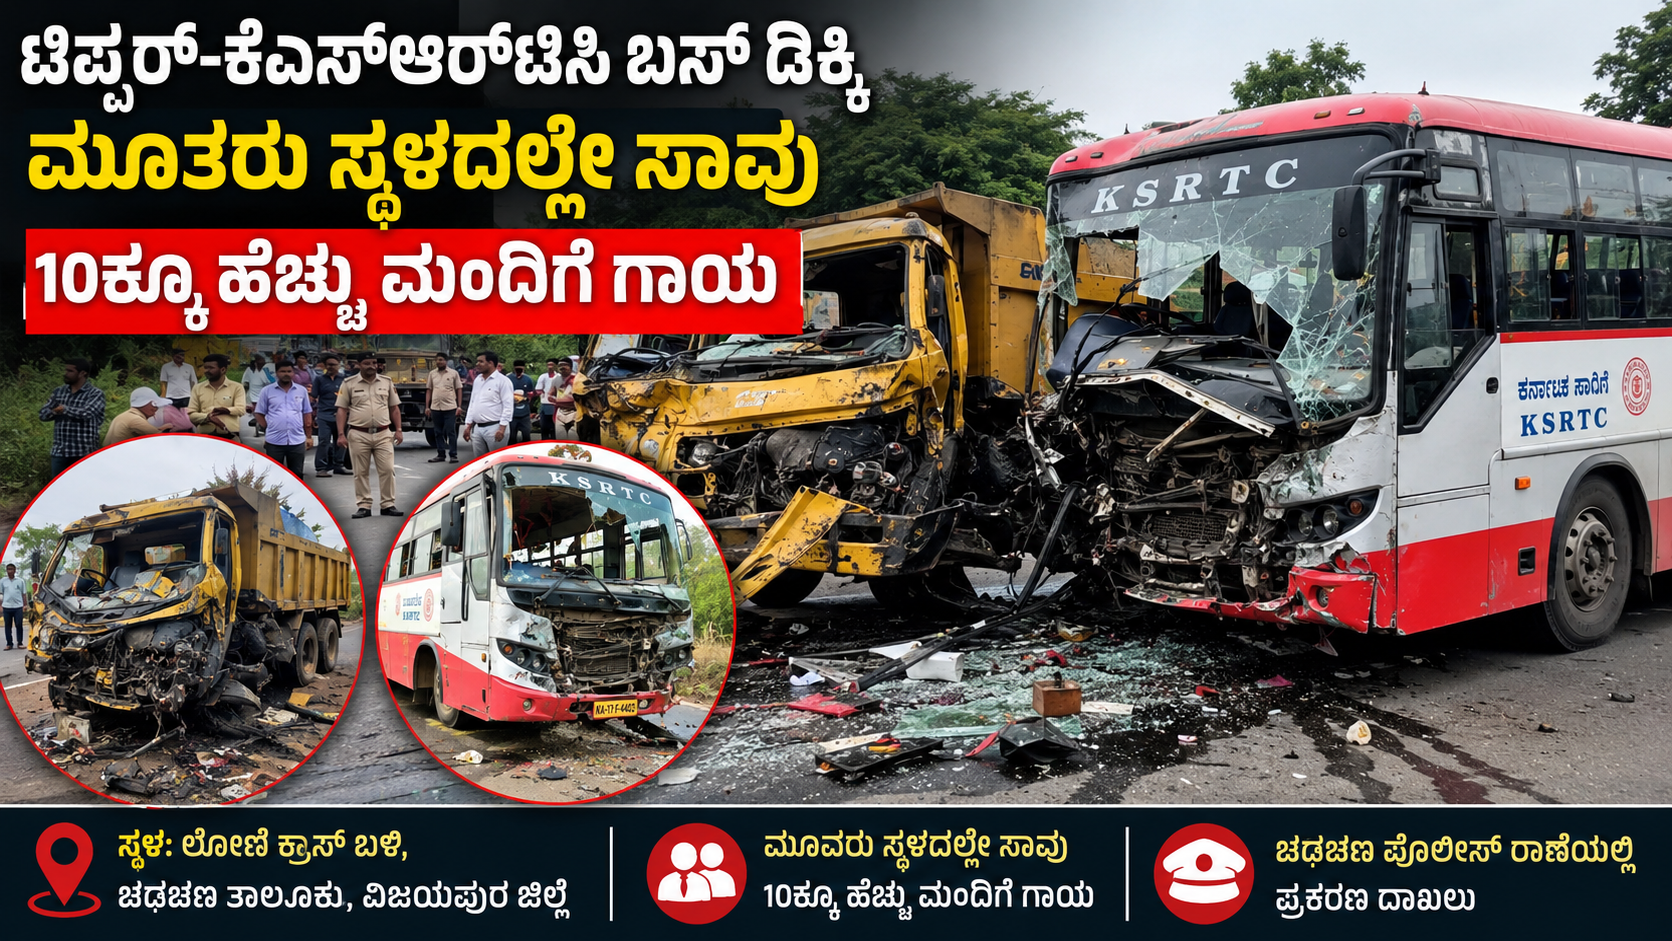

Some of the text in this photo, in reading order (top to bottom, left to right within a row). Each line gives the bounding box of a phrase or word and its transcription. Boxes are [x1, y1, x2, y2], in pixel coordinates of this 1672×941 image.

[1090, 158, 1298, 214] KSRTC
[1520, 407, 1608, 437] KSRTC
[548, 471, 652, 505] KSRTC
